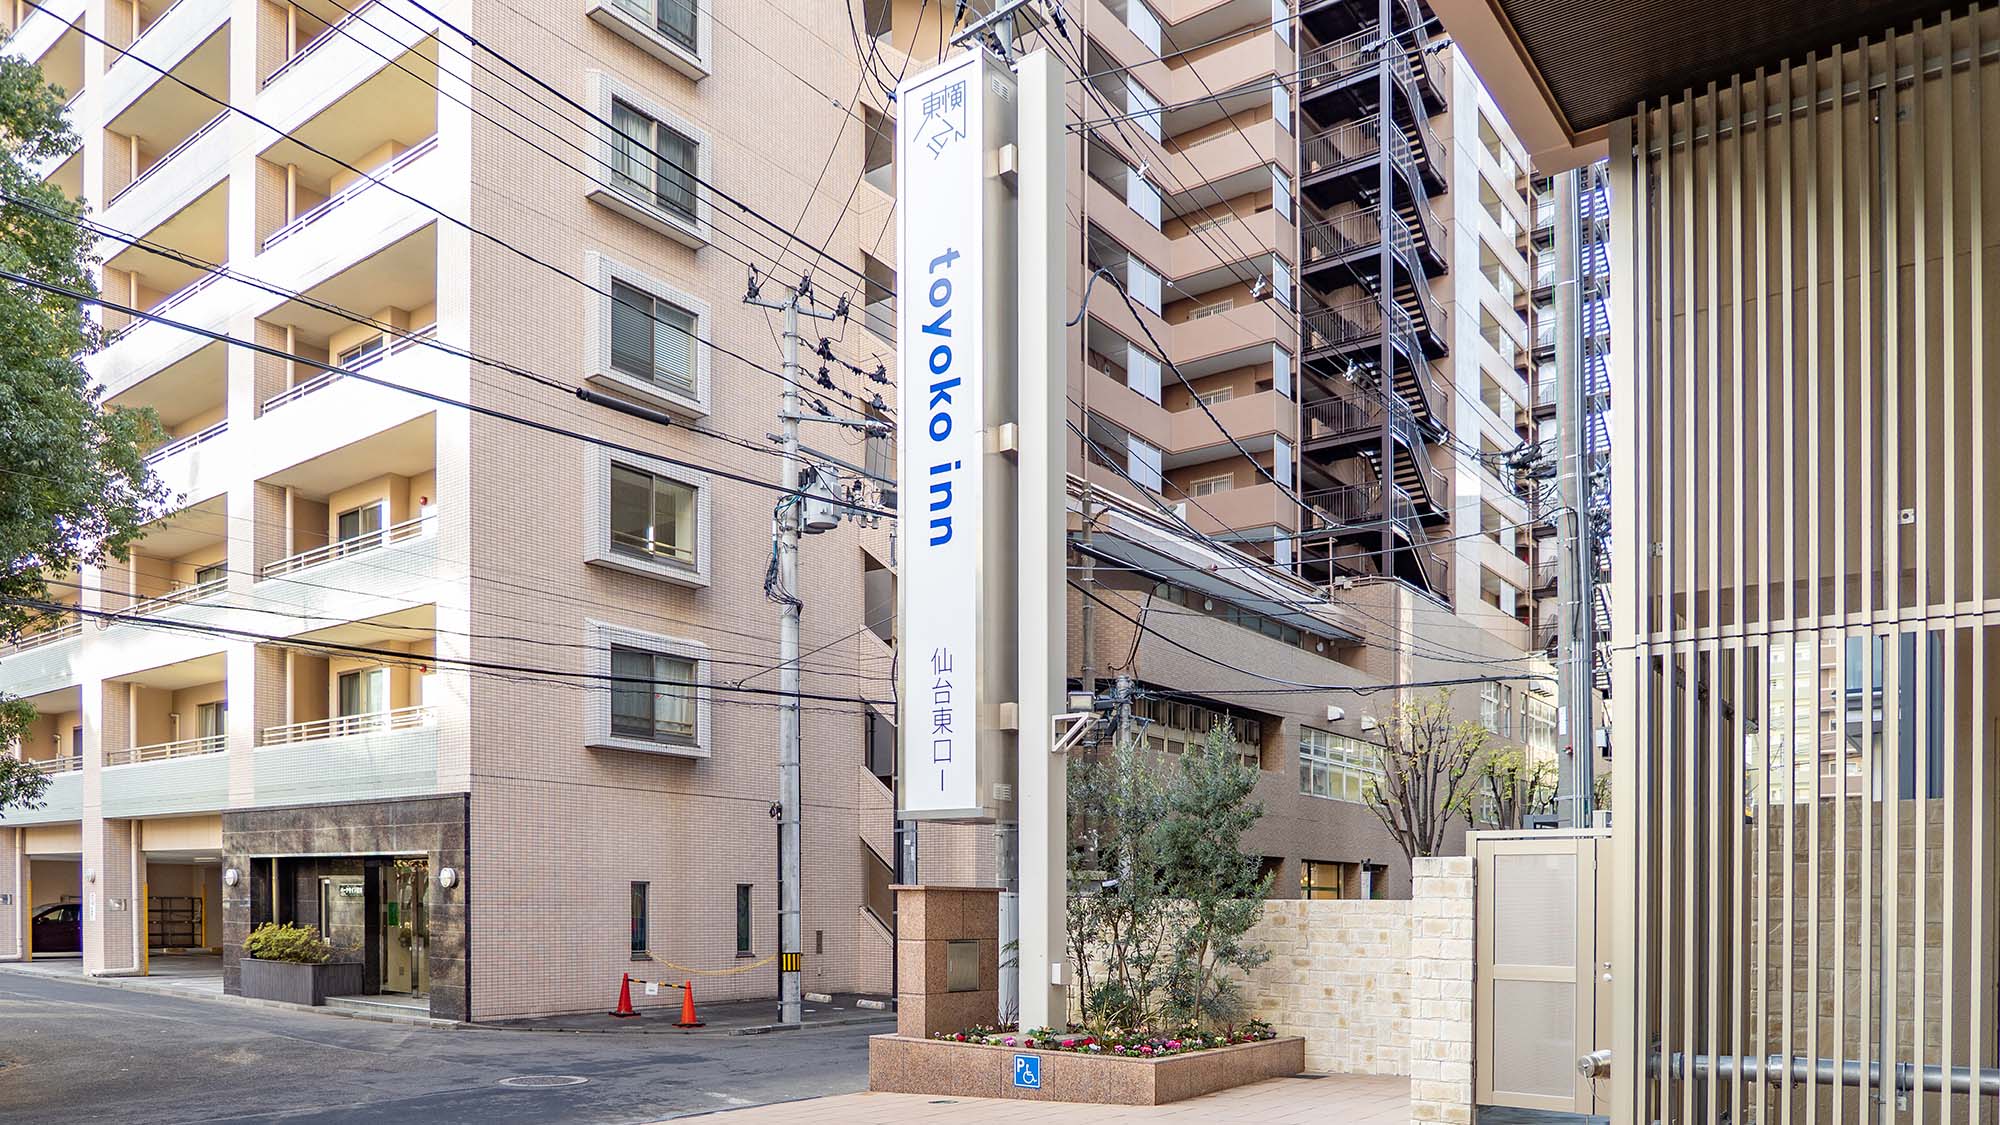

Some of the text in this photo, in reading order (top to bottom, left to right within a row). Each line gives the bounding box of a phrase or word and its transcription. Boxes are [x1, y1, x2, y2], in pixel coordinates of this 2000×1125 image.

[922, 248, 961, 547] toyoko inn
[1016, 1058, 1025, 1073] P
